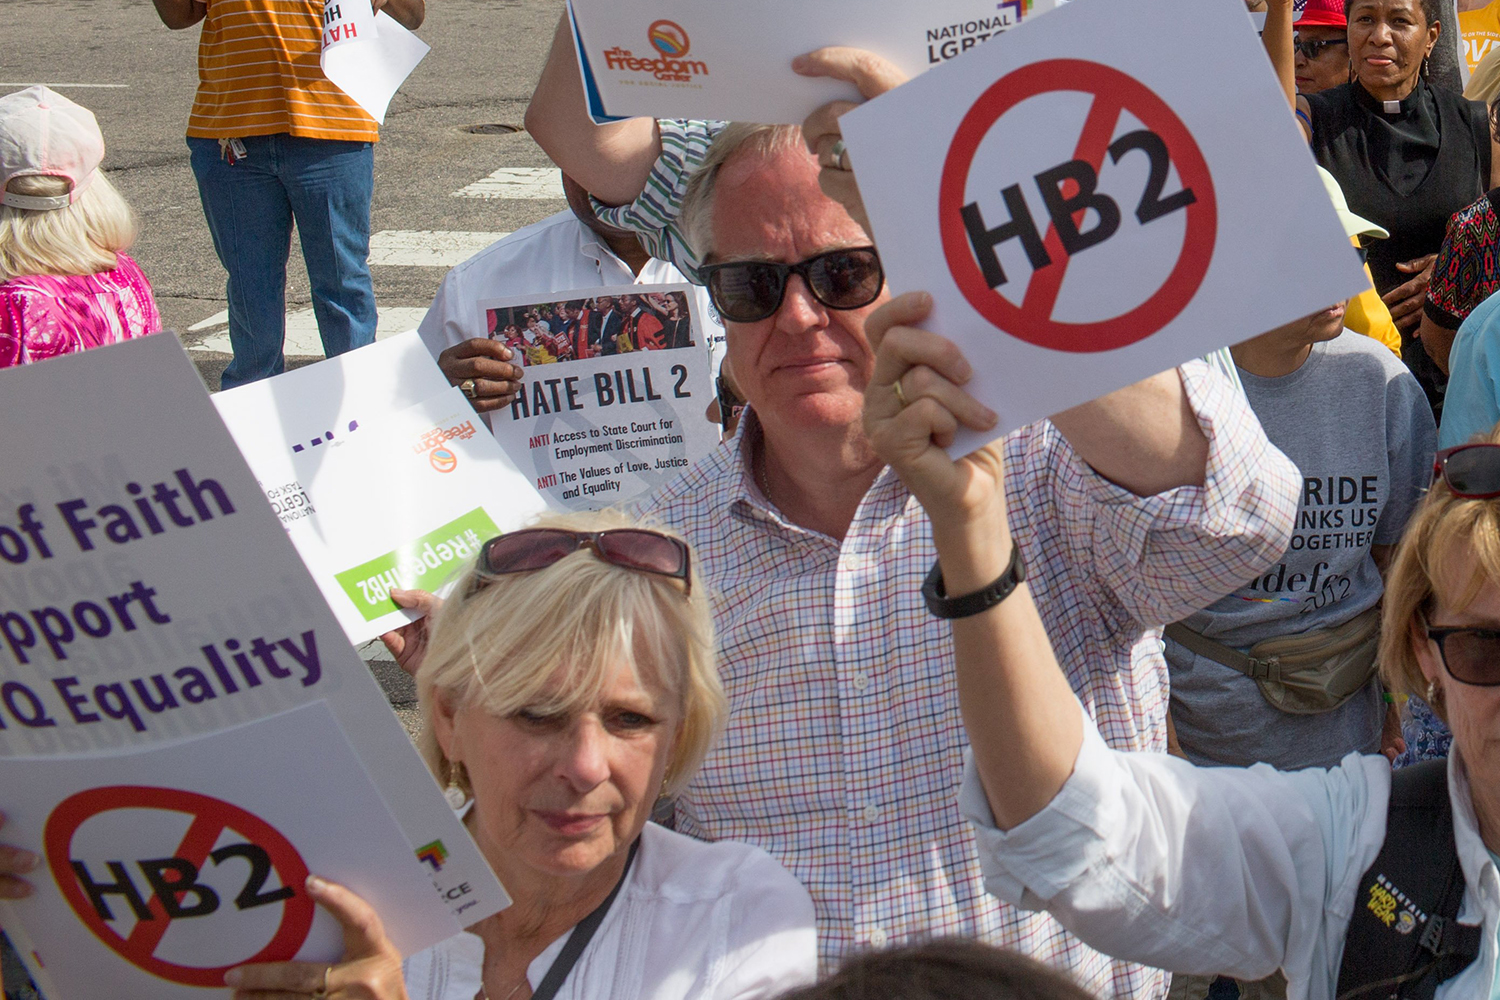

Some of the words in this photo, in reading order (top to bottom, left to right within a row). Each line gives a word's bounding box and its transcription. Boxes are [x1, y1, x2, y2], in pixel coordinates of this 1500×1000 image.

[926, 15, 1011, 43] NATIONAL
[603, 50, 709, 76] Freedom
[653, 70, 692, 82] Center
[959, 128, 1198, 290] HB2
[510, 375, 584, 421] HATE
[593, 366, 662, 408] BILL
[670, 364, 692, 399] 2
[412, 420, 477, 455] Freedom
[529, 433, 551, 449] ANTI
[553, 430, 587, 445] Access
[588, 428, 600, 439] to
[602, 423, 629, 437] State
[630, 420, 657, 434] Court
[659, 418, 674, 430] for
[554, 441, 614, 461] Employment
[615, 434, 683, 451] Discrimination
[281, 481, 303, 496] TASK
[536, 474, 557, 491] ANTI
[558, 470, 577, 485] The
[579, 465, 612, 480] Values
[613, 462, 624, 474] of
[626, 460, 652, 473] Love,
[654, 456, 689, 470] Justice
[562, 486, 581, 500] and
[582, 479, 622, 497] Equality
[1304, 475, 1378, 507] RIDE
[0, 502, 54, 566] of
[55, 466, 236, 555] Faith
[1294, 509, 1345, 530] INKS
[1351, 507, 1378, 527] US
[1290, 530, 1373, 551] OGETHER
[53, 629, 325, 733] Equality
[69, 842, 297, 924] HB2
[1370, 883, 1397, 911] HARD
[1377, 873, 1428, 923] MOUNTAIN
[1367, 897, 1396, 928] WEAR
